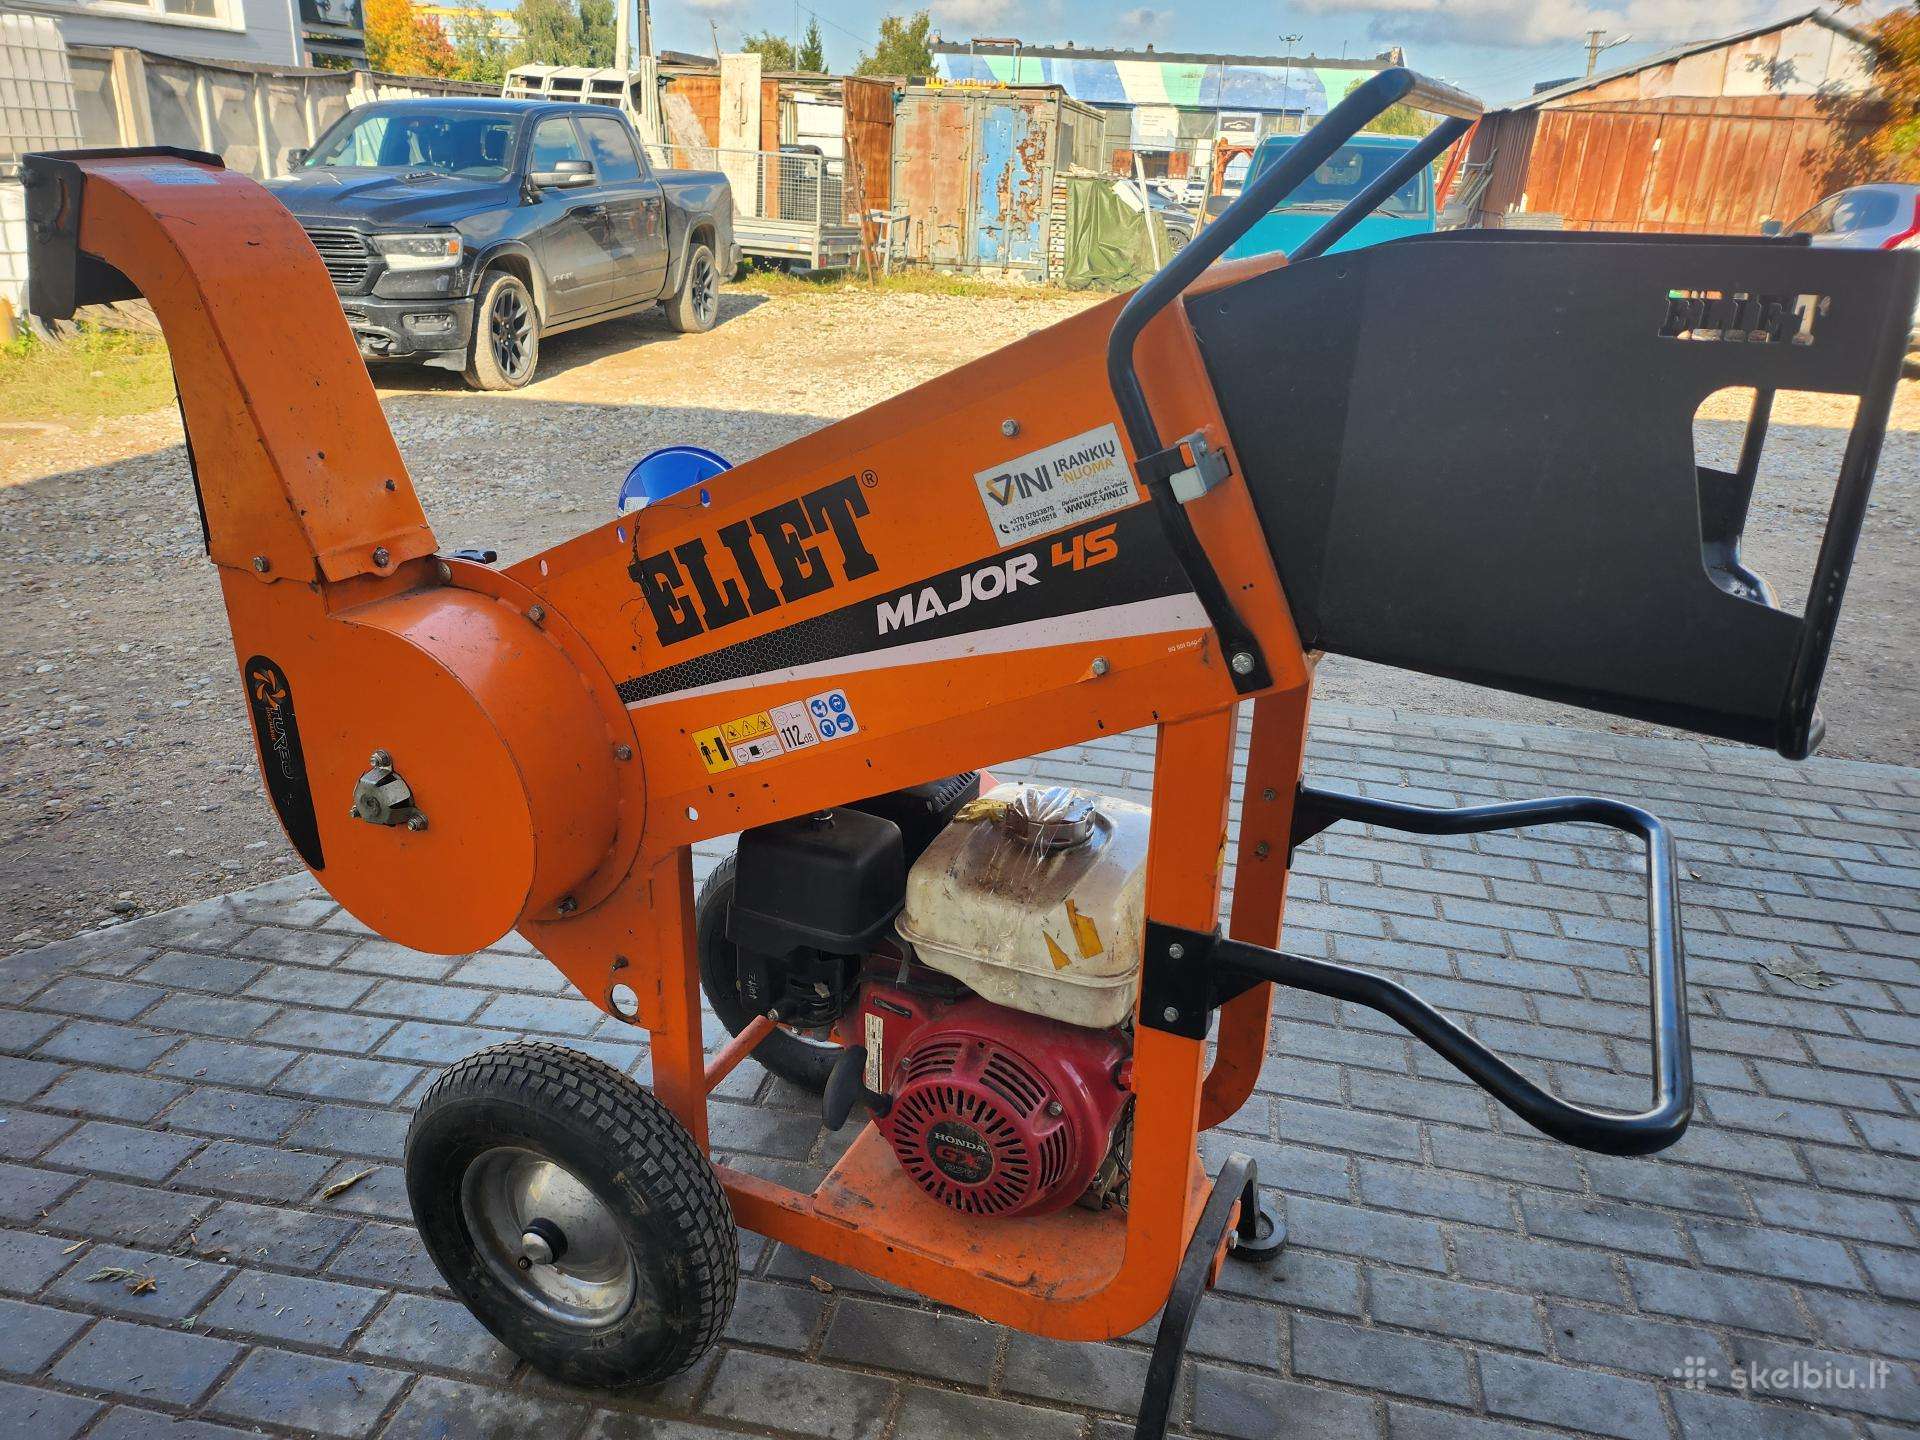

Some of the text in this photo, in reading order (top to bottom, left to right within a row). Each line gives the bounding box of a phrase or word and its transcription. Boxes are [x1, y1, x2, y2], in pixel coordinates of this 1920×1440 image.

[1658, 289, 1818, 346] ELIET
[1053, 440, 1116, 477] ĮRANKIŲ
[1063, 458, 1114, 484] NUOMA
[876, 553, 1041, 636] MAJOR
[781, 725, 814, 748] 112 dB
[934, 1132, 987, 1153] HONDA
